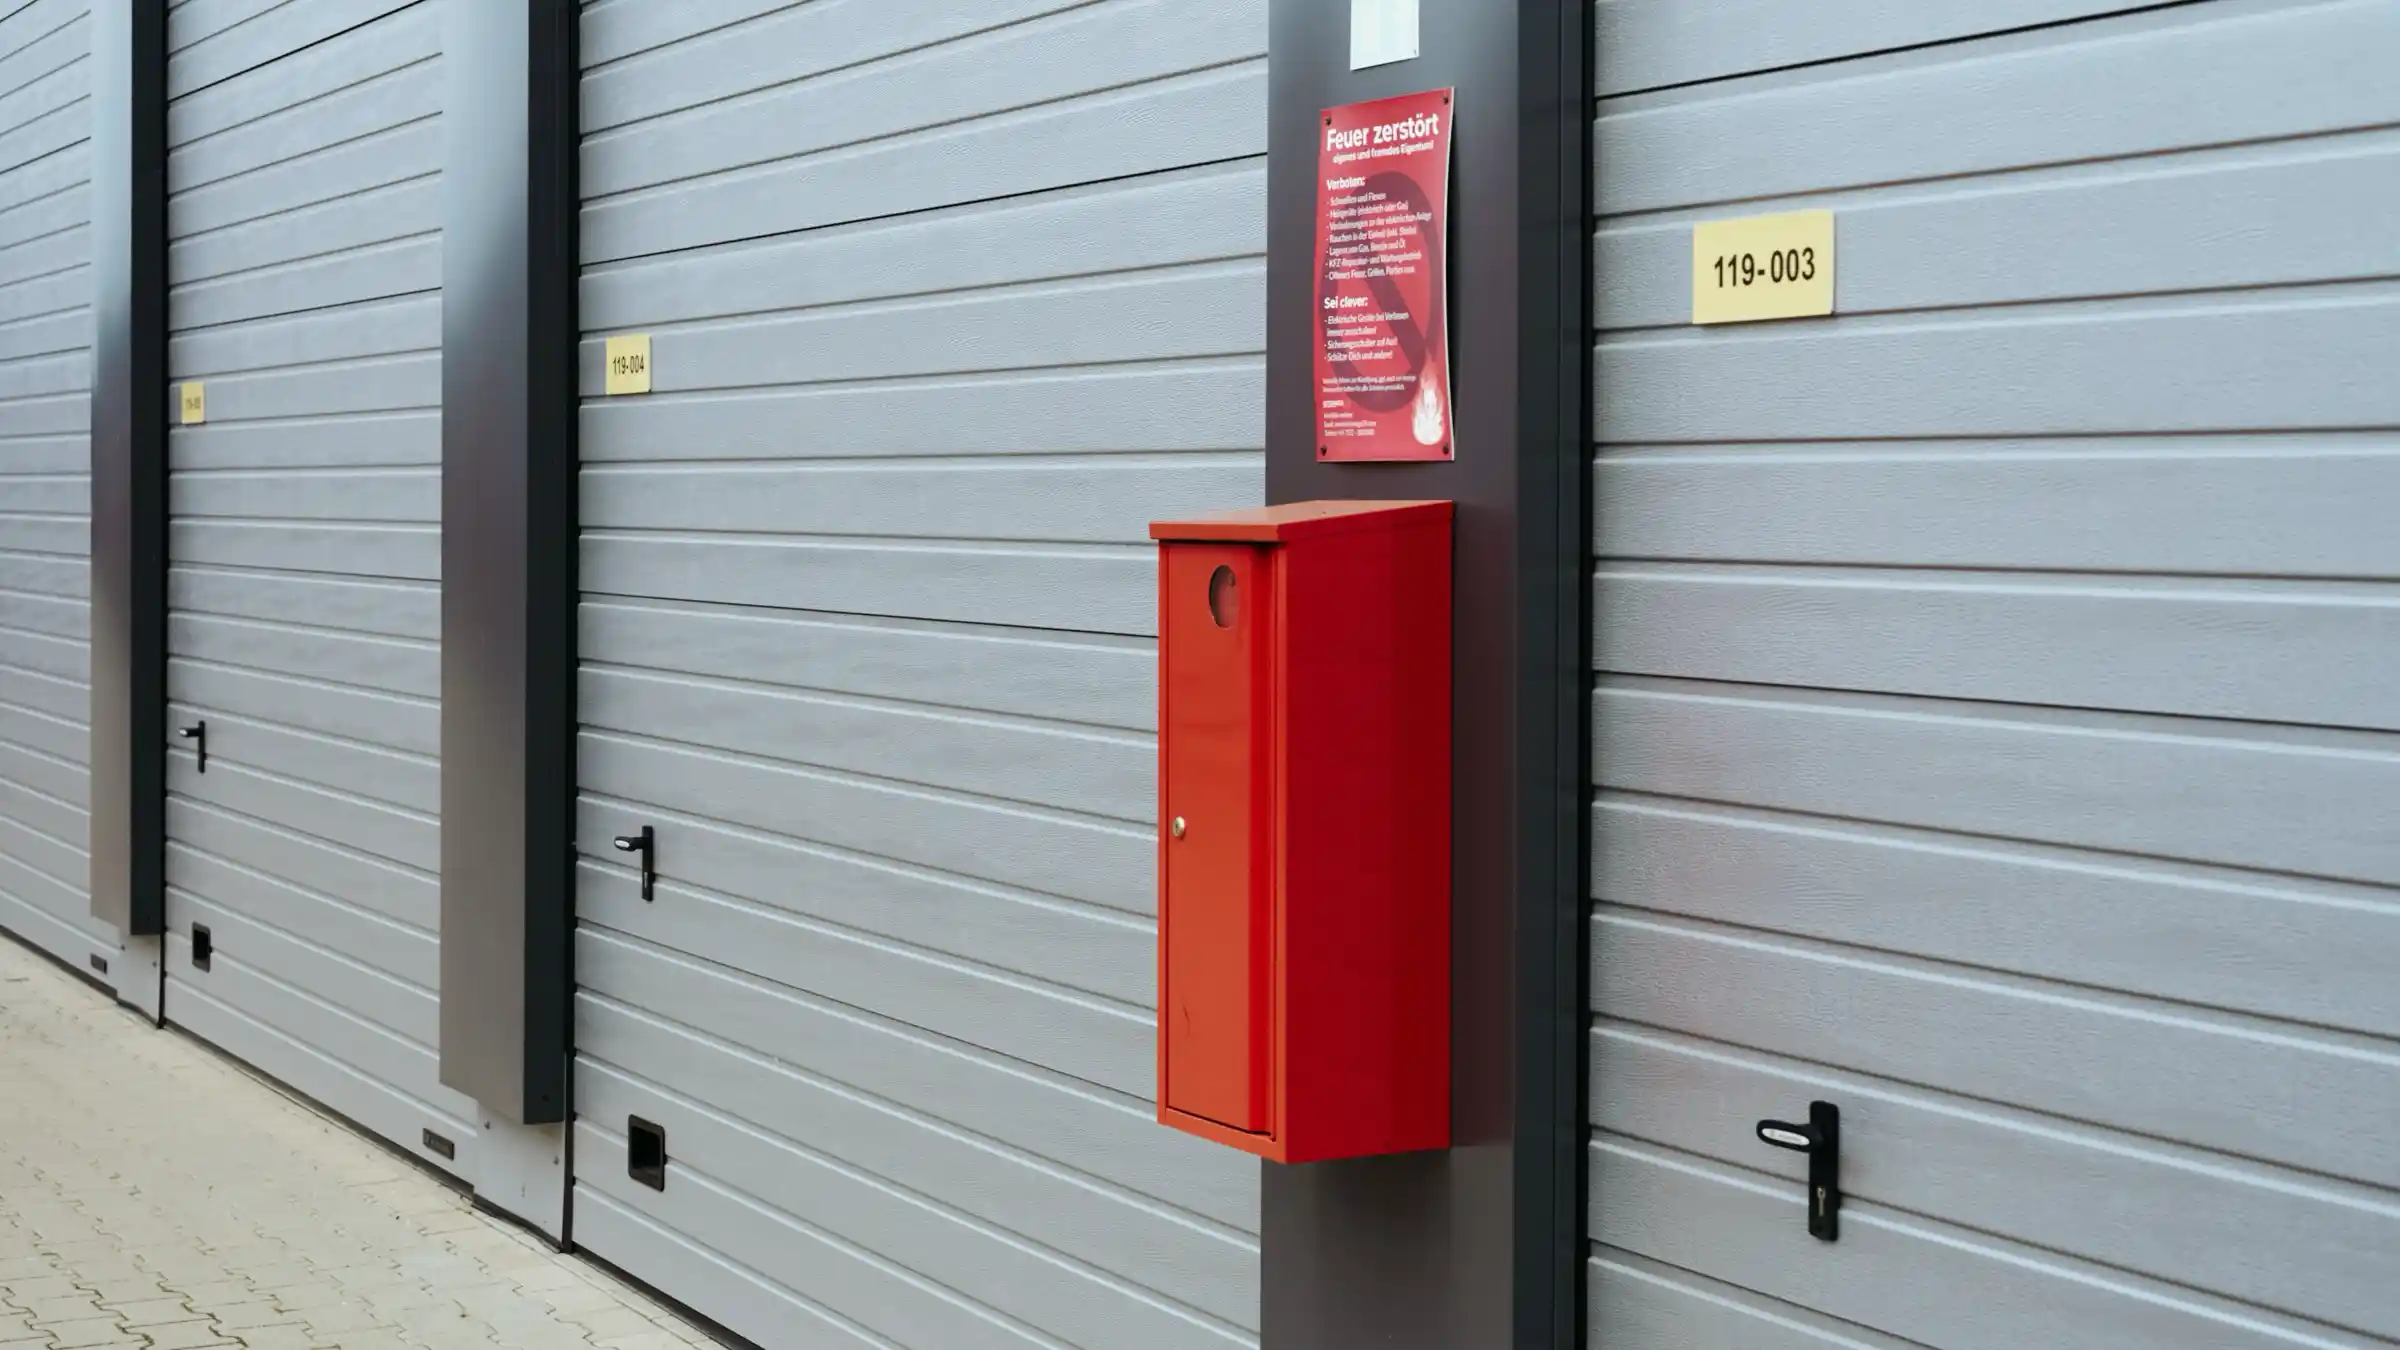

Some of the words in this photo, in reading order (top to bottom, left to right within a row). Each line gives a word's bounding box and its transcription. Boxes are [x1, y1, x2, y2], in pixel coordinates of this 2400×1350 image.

[1326, 128, 1370, 151] Feuer
[1373, 112, 1439, 144] zerstört
[1357, 149, 1371, 160] und
[1326, 176, 1366, 190] Verboten:
[1714, 246, 1816, 288] 119-003
[1323, 296, 1338, 309] Sei
[1339, 296, 1368, 308] clever:
[612, 352, 645, 375] 119-004
